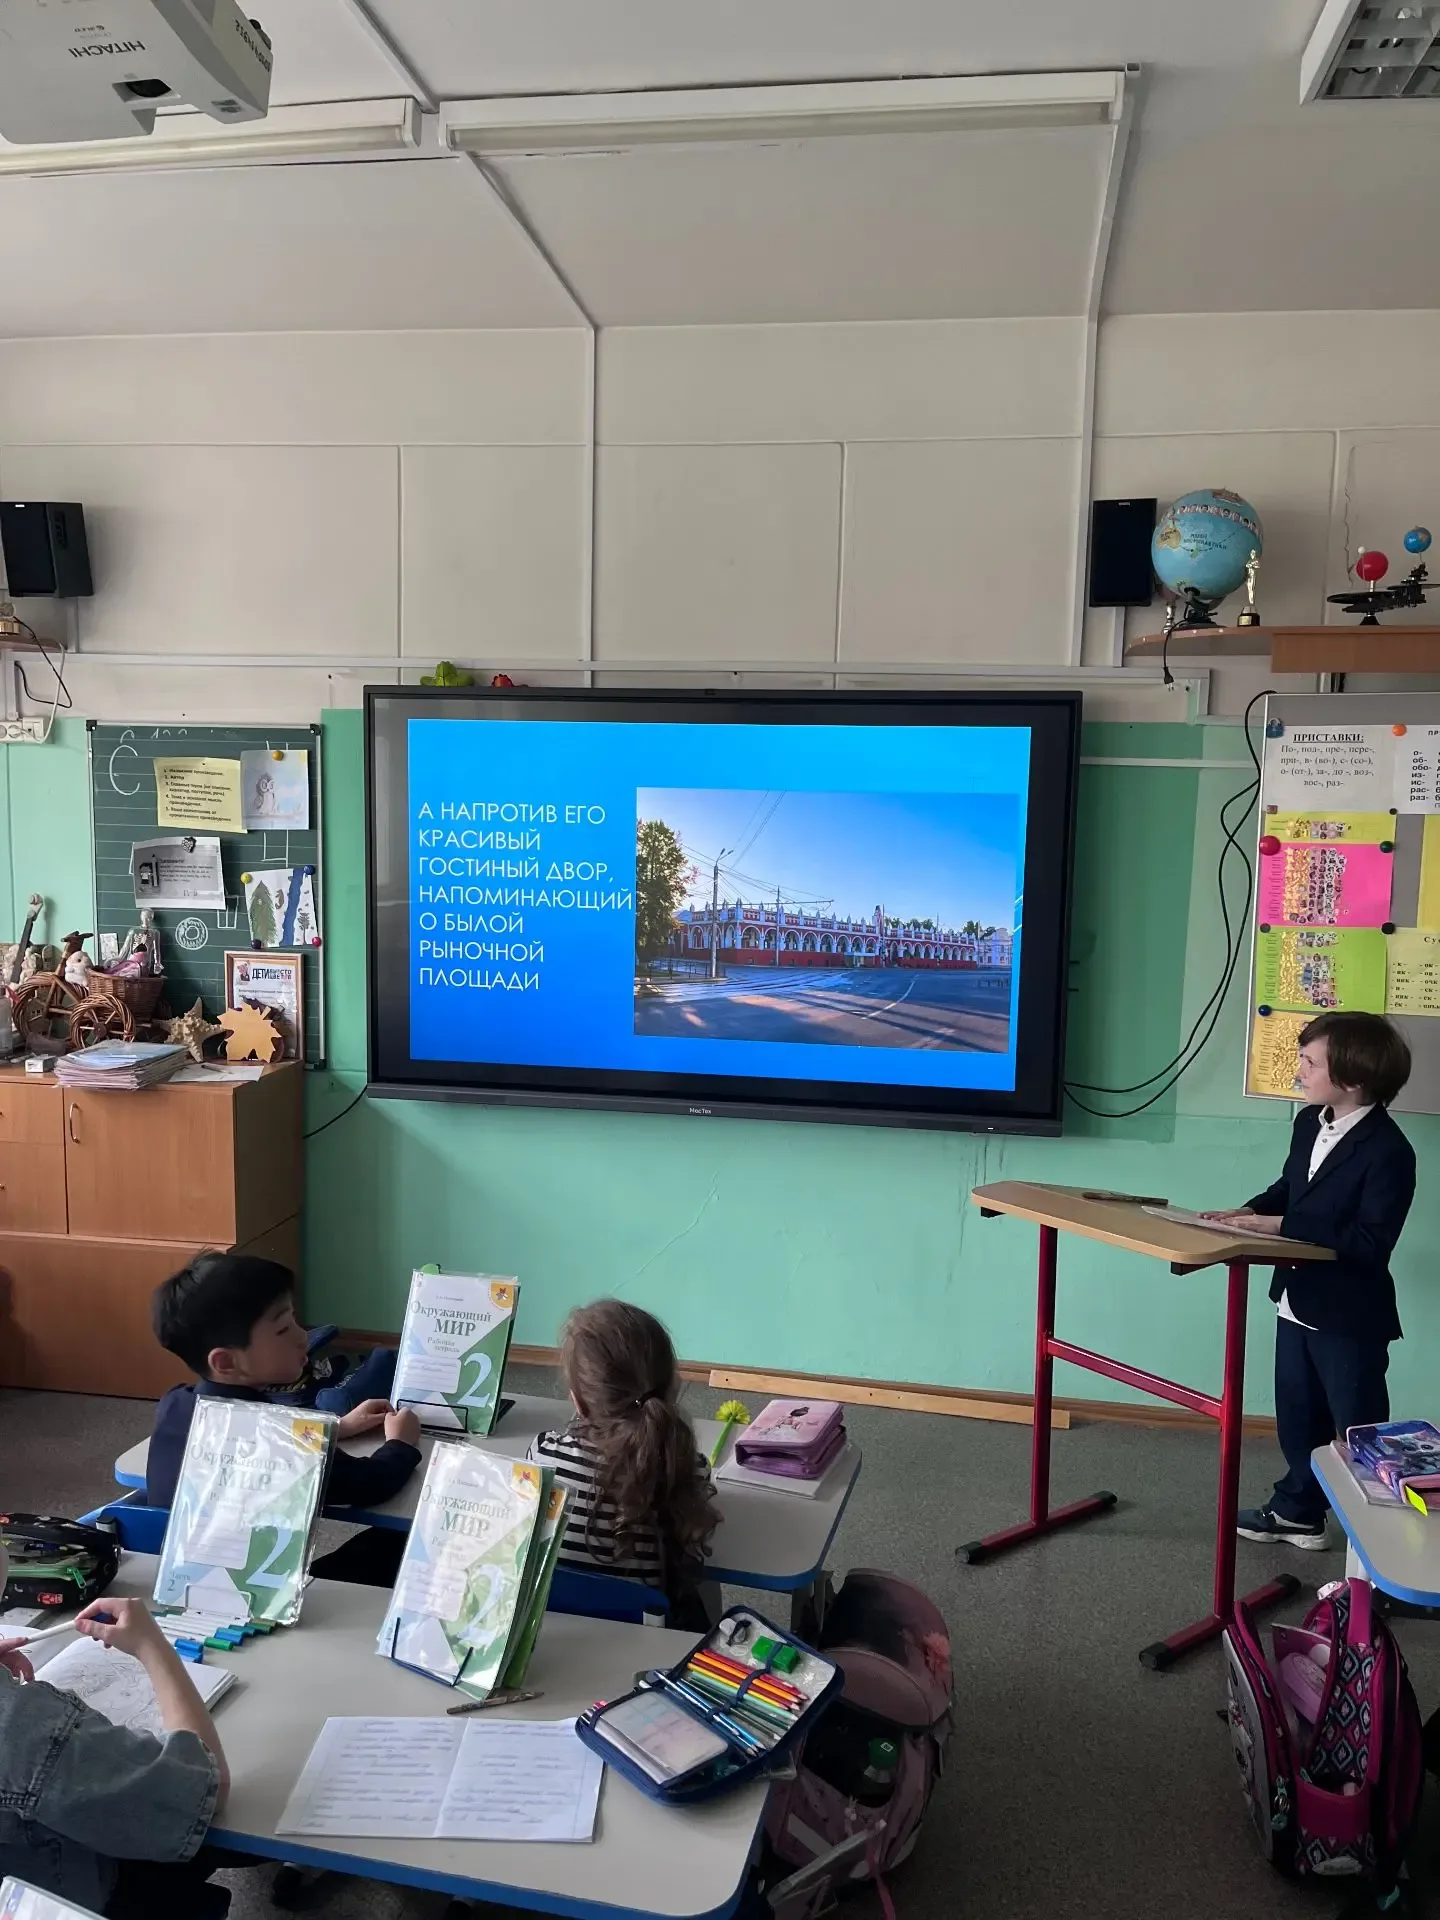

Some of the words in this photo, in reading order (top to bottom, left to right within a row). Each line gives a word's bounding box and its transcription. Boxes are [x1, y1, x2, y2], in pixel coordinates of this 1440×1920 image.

[67, 40, 147, 58] HITACHI
[1293, 733, 1364, 743] ПРИСТАВКИ:
[417, 801, 434, 820] А
[441, 802, 558, 824] НАПРОТИВ
[565, 805, 606, 825] ЕГО
[418, 828, 542, 851] КРАСИВЫЙ
[419, 856, 540, 879] ГОСТИНЫЙ
[545, 861, 614, 883] ДВОР,
[419, 885, 633, 912] НАПОМИНАЮЩИЙ
[419, 912, 438, 931] О
[444, 912, 524, 934] БЫЛОЙ
[419, 940, 545, 963] РЫНОЧНОЙ
[419, 967, 540, 992] ПЛОЩАДИ
[410, 1301, 492, 1322] Окружающий
[434, 1318, 476, 1337] МИР
[457, 1352, 493, 1408] 2
[190, 1443, 293, 1473] Окжающй
[421, 1484, 510, 1520] Оружающий
[440, 1510, 490, 1539] МИР
[245, 1514, 295, 1590] 2
[167, 1579, 175, 1592] 2
[456, 1564, 505, 1649] 2
